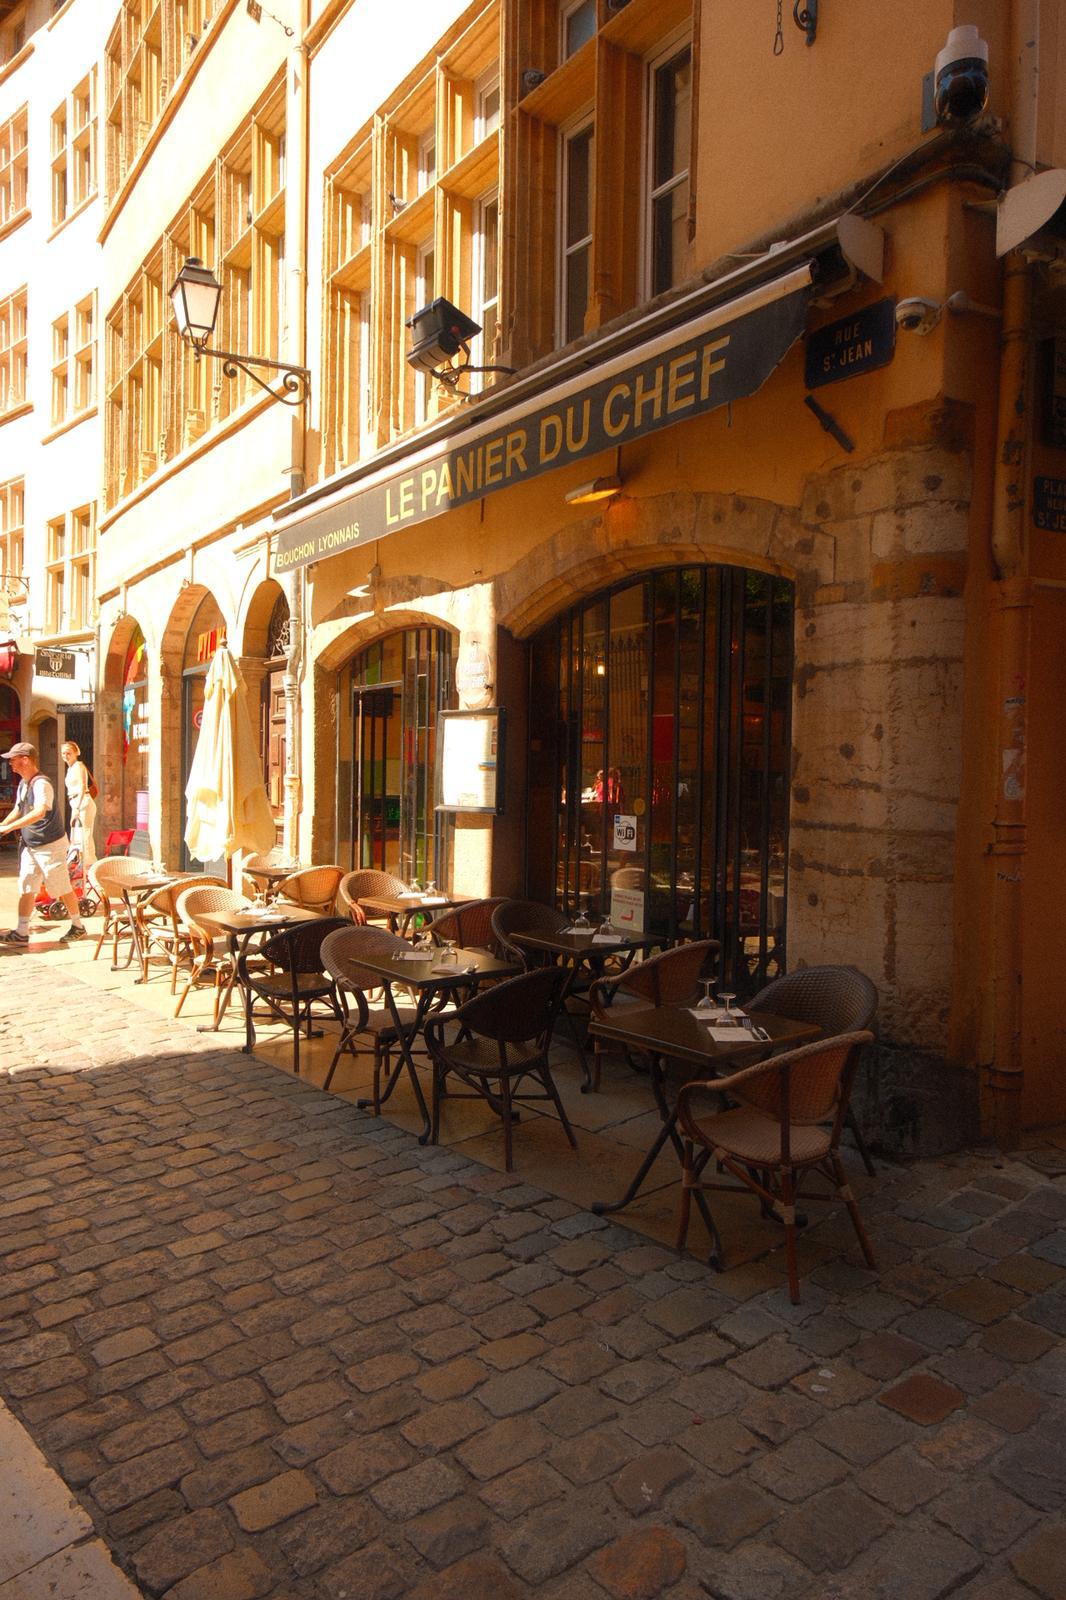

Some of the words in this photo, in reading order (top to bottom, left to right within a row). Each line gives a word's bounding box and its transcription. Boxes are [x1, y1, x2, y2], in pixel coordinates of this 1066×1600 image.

[835, 322, 861, 345] RUE
[839, 340, 872, 366] JEAN
[385, 478, 414, 526] LE
[421, 428, 528, 512] PANIER
[540, 399, 591, 464] DU
[603, 335, 731, 438] CHEF
[276, 540, 315, 568] BOUCHON
[318, 522, 360, 552] LYONNAIS
